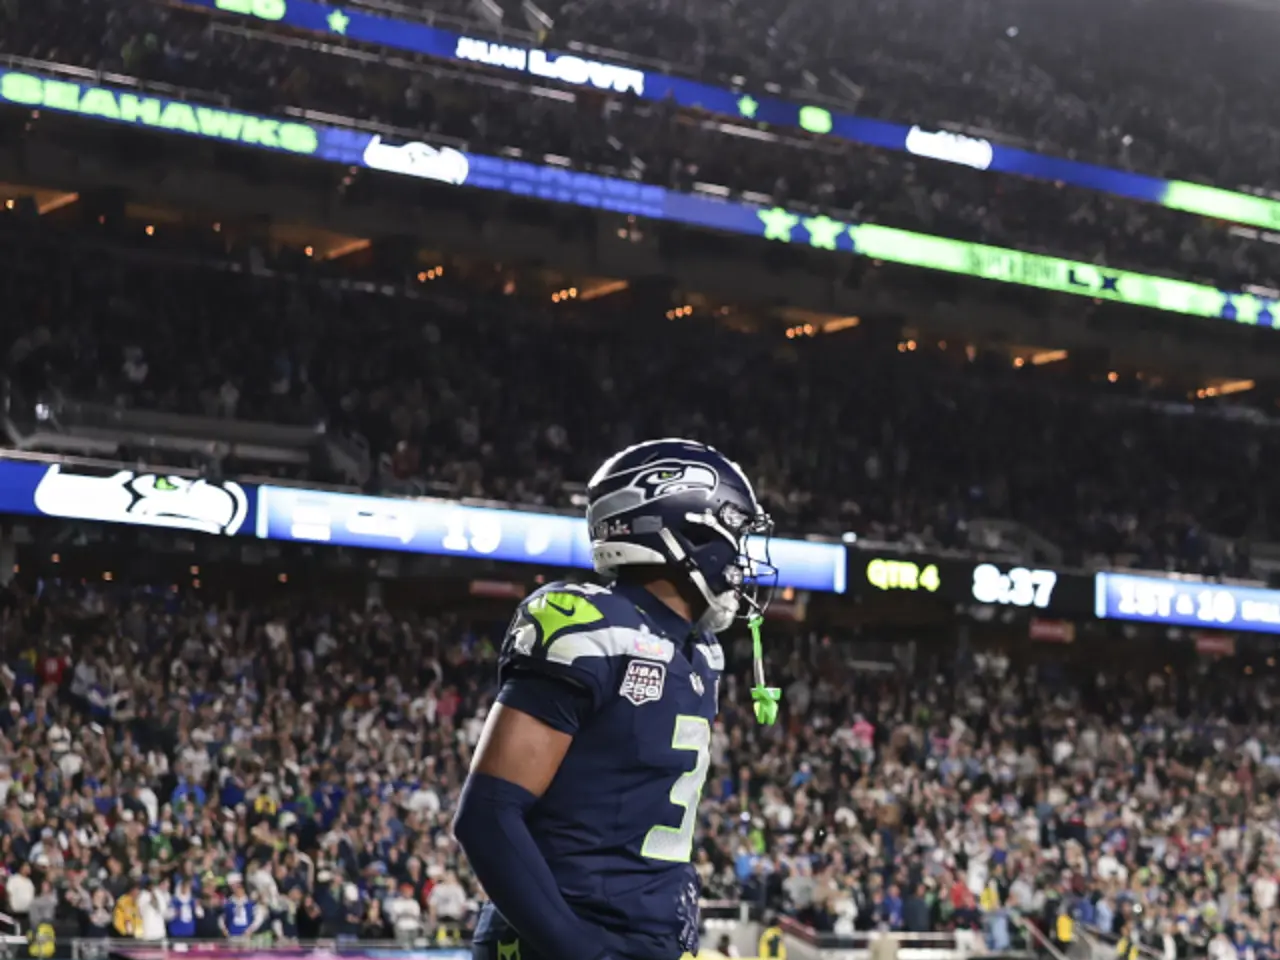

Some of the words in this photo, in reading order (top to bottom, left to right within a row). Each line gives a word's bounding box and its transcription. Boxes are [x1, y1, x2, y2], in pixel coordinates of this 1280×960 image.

[0, 71, 319, 154] SEAHAWKS
[919, 564, 941, 592] 4
[628, 665, 660, 680] USA
[622, 681, 659, 699] 250
[640, 713, 711, 862] 3
